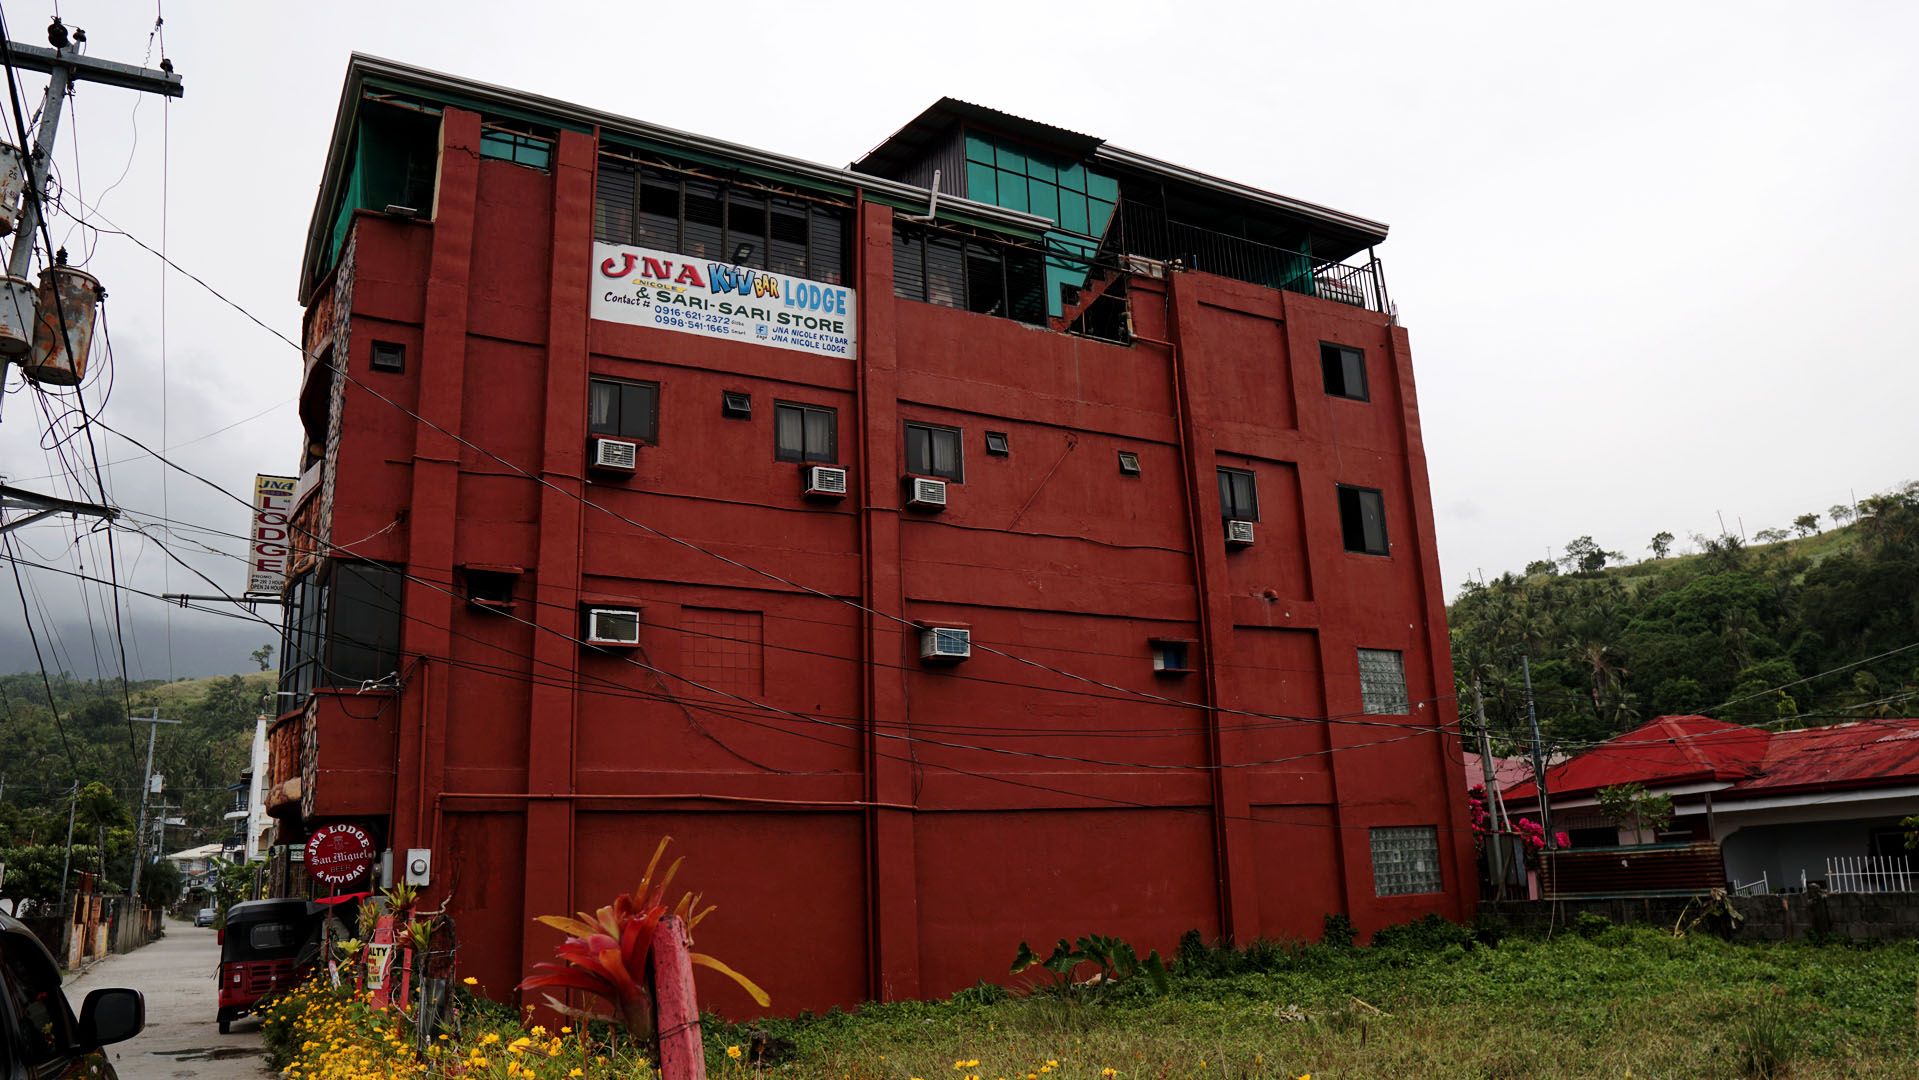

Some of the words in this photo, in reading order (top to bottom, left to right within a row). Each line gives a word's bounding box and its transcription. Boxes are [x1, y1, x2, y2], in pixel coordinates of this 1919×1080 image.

[600, 252, 706, 288] JNA
[707, 262, 756, 296] KTV
[753, 273, 780, 299] BAR
[784, 278, 847, 316] LODGE
[639, 279, 678, 292] NICOLE
[604, 291, 641, 307] Contact
[636, 286, 651, 299] &
[656, 290, 771, 321] SARI-SARI
[776, 311, 844, 334] STORE
[772, 326, 790, 336] JNA
[790, 328, 817, 340] NICOLE
[770, 334, 789, 344] JNA
[790, 337, 820, 349] NICOLE
[822, 341, 846, 354] LODGE
[258, 479, 294, 491] JNA
[256, 497, 288, 573] LODGE
[308, 832, 327, 856] JNA
[328, 824, 370, 848] LODGE
[311, 855, 332, 866] San
[332, 849, 368, 863] Miguel
[324, 874, 345, 883] KTV
[345, 864, 366, 882] BAR
